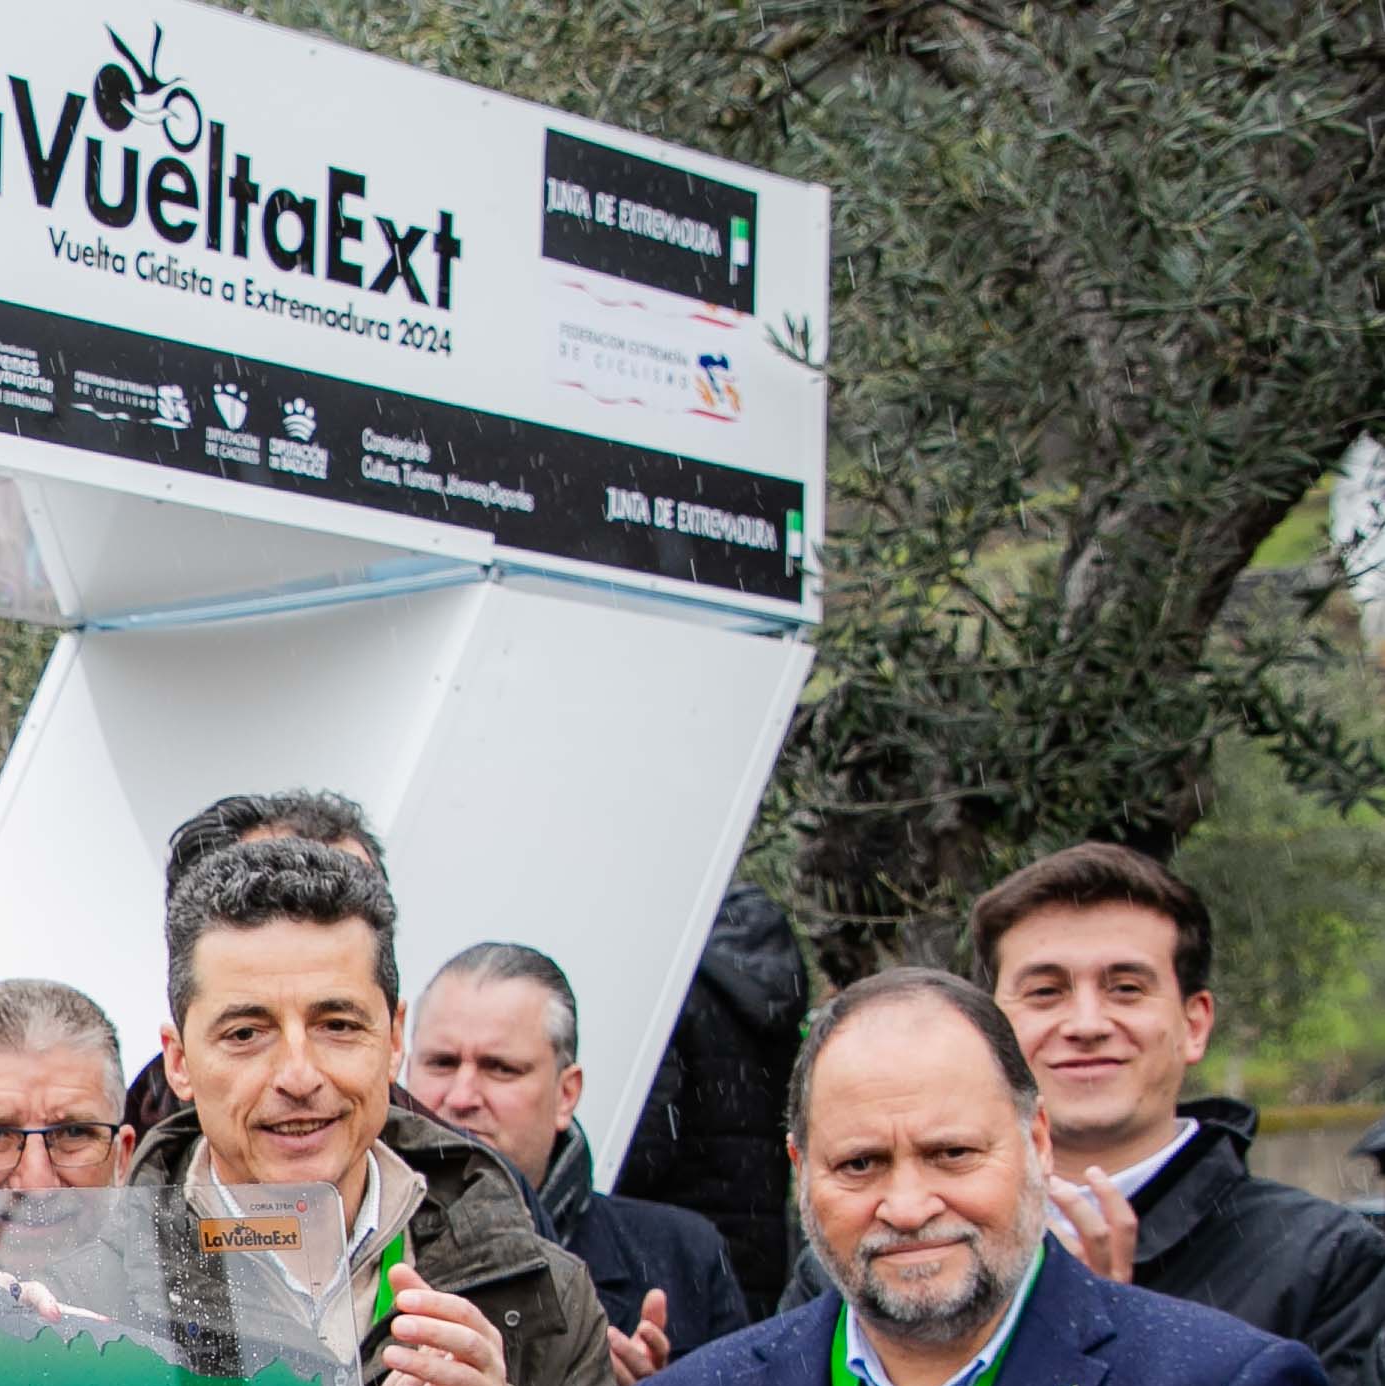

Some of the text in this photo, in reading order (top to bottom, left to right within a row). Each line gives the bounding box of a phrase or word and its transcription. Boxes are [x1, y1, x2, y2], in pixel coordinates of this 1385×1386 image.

[546, 177, 723, 258] JUNTA DE EXTREMADURA
[48, 227, 453, 356] Vuelta Ciclista a Extremadura 2024
[605, 487, 778, 552] JUNTA DE EXTREMADURA
[204, 1230, 298, 1248] LaVueltaExt
